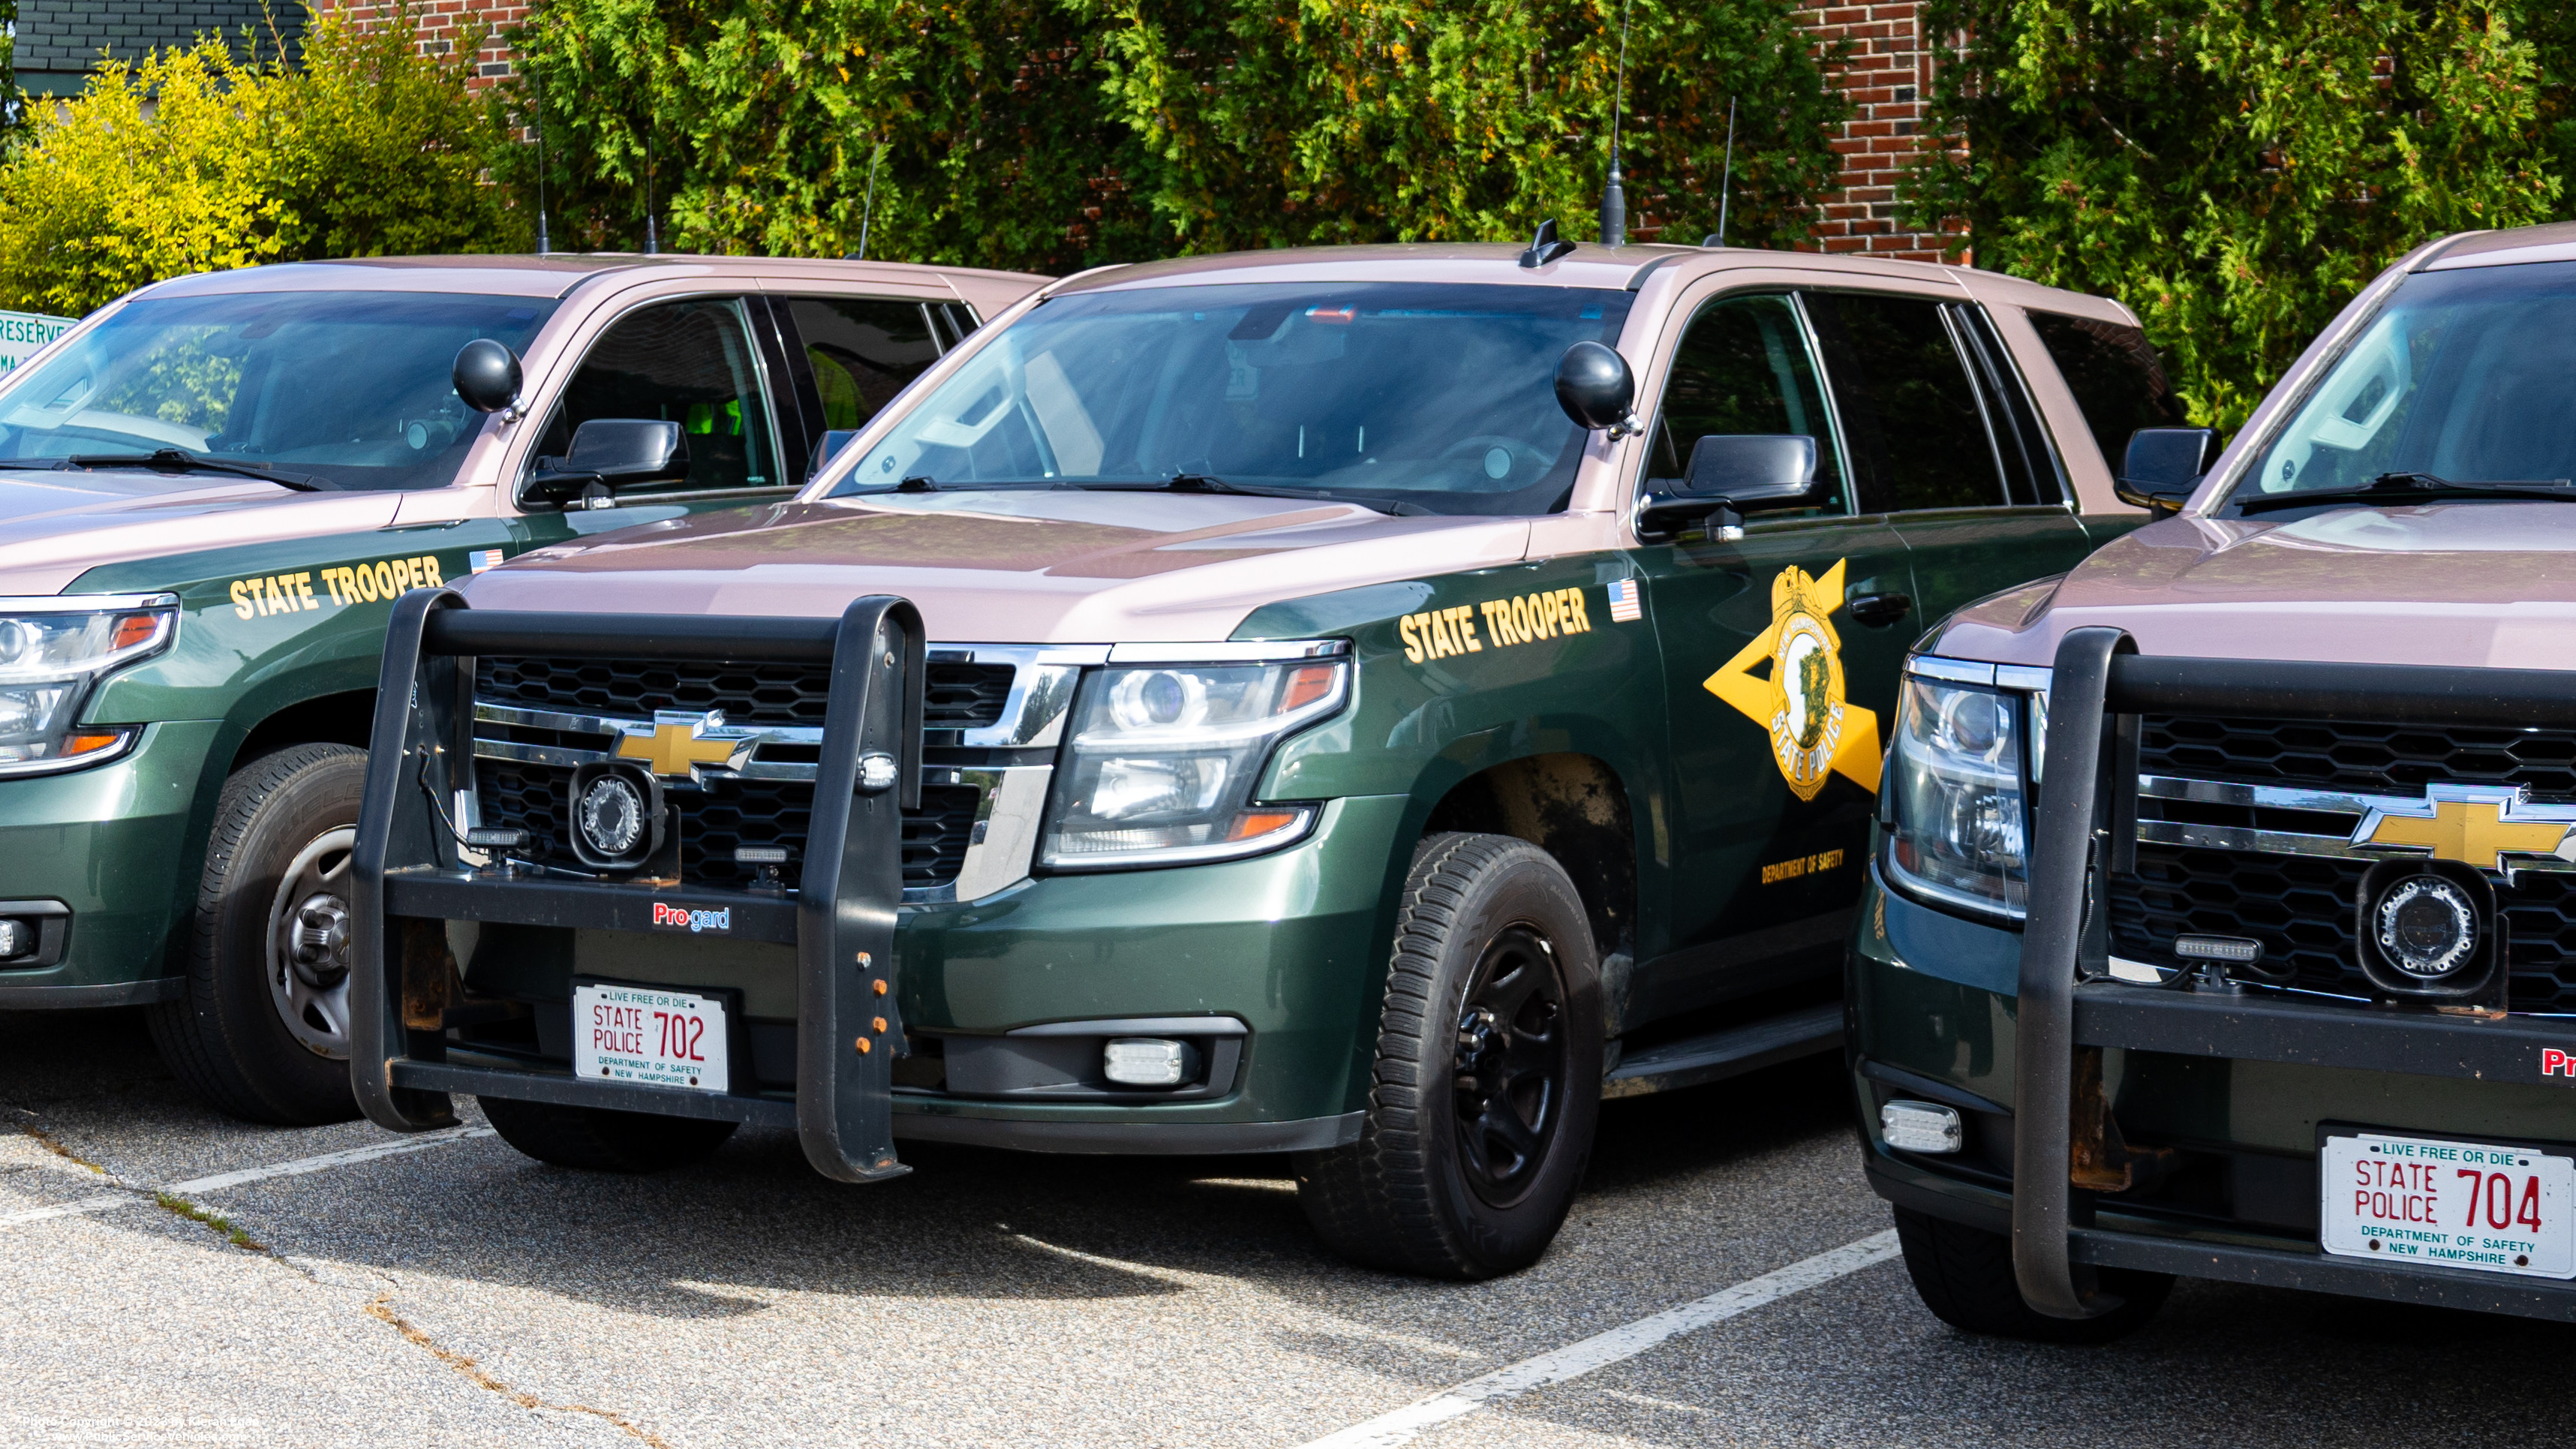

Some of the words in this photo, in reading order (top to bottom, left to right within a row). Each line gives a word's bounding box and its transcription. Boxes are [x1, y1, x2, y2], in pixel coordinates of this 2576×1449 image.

[0, 320, 69, 344] RESERV
[230, 571, 320, 620] STATE
[321, 555, 444, 606] TROOPER
[1399, 605, 1482, 664] STATE
[1480, 587, 1591, 648] TROOPER
[1778, 629, 1791, 660] NEW
[1772, 709, 1805, 781] STATE
[1808, 700, 1844, 781] POLICE
[1762, 857, 1805, 884] DEPARTMENT
[1808, 855, 1817, 873] OF
[1818, 849, 1844, 871] SAFETY
[609, 991, 628, 1002] LIVE
[631, 994, 654, 1004] FREE
[657, 997, 669, 1006] OR
[672, 999, 687, 1009] DIE
[594, 1005, 642, 1030] STATE
[654, 1011, 705, 1062] 702
[594, 1029, 643, 1054] POLICE
[598, 1056, 651, 1069] DEPARTMENT
[654, 1063, 666, 1072] OF
[670, 1064, 702, 1075] SAFETY
[615, 1069, 633, 1078] NEW
[638, 1072, 684, 1084] HAMPSHIRE
[2383, 1143, 2414, 1156] LIVE
[2420, 1147, 2457, 1160] FREE
[2463, 1150, 2484, 1163] OR
[2490, 1153, 2514, 1166] DIE
[2355, 1190, 2438, 1224] POLICE
[2356, 1160, 2437, 1192] STATE
[2457, 1169, 2542, 1233] 704
[2361, 1225, 2448, 1244] DEPARTMENT
[2457, 1236, 2475, 1246] OF
[2483, 1238, 2535, 1253] SAFETY
[2389, 1243, 2418, 1255] NEW
[2429, 1247, 2506, 1265] HAMPSHIRE
